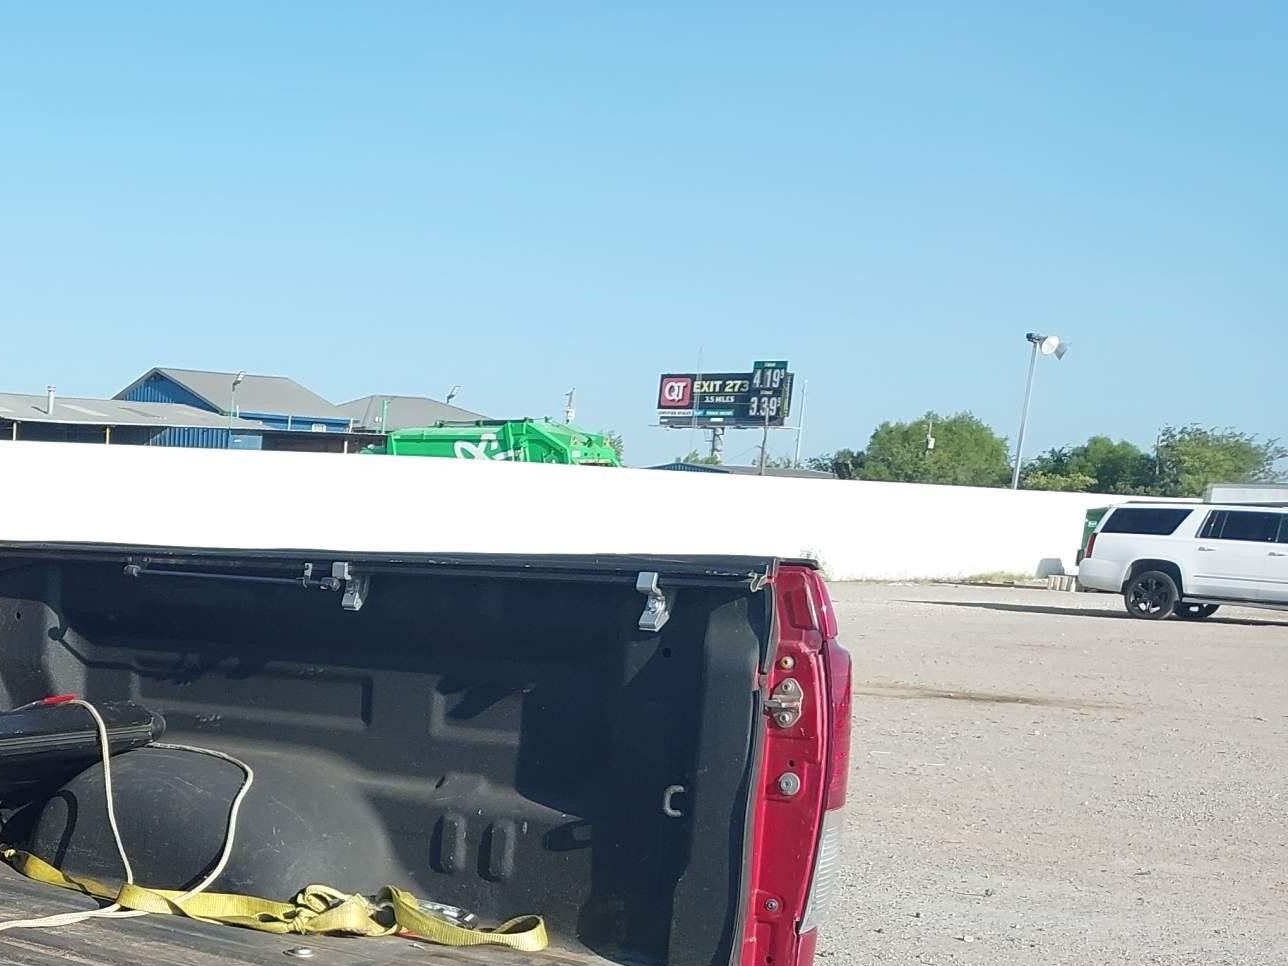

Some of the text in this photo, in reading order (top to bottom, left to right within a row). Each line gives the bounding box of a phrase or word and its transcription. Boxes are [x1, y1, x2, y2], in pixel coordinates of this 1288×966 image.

[665, 381, 688, 403] QT
[693, 380, 750, 392] EXIT 273
[715, 395, 736, 403] MILES
